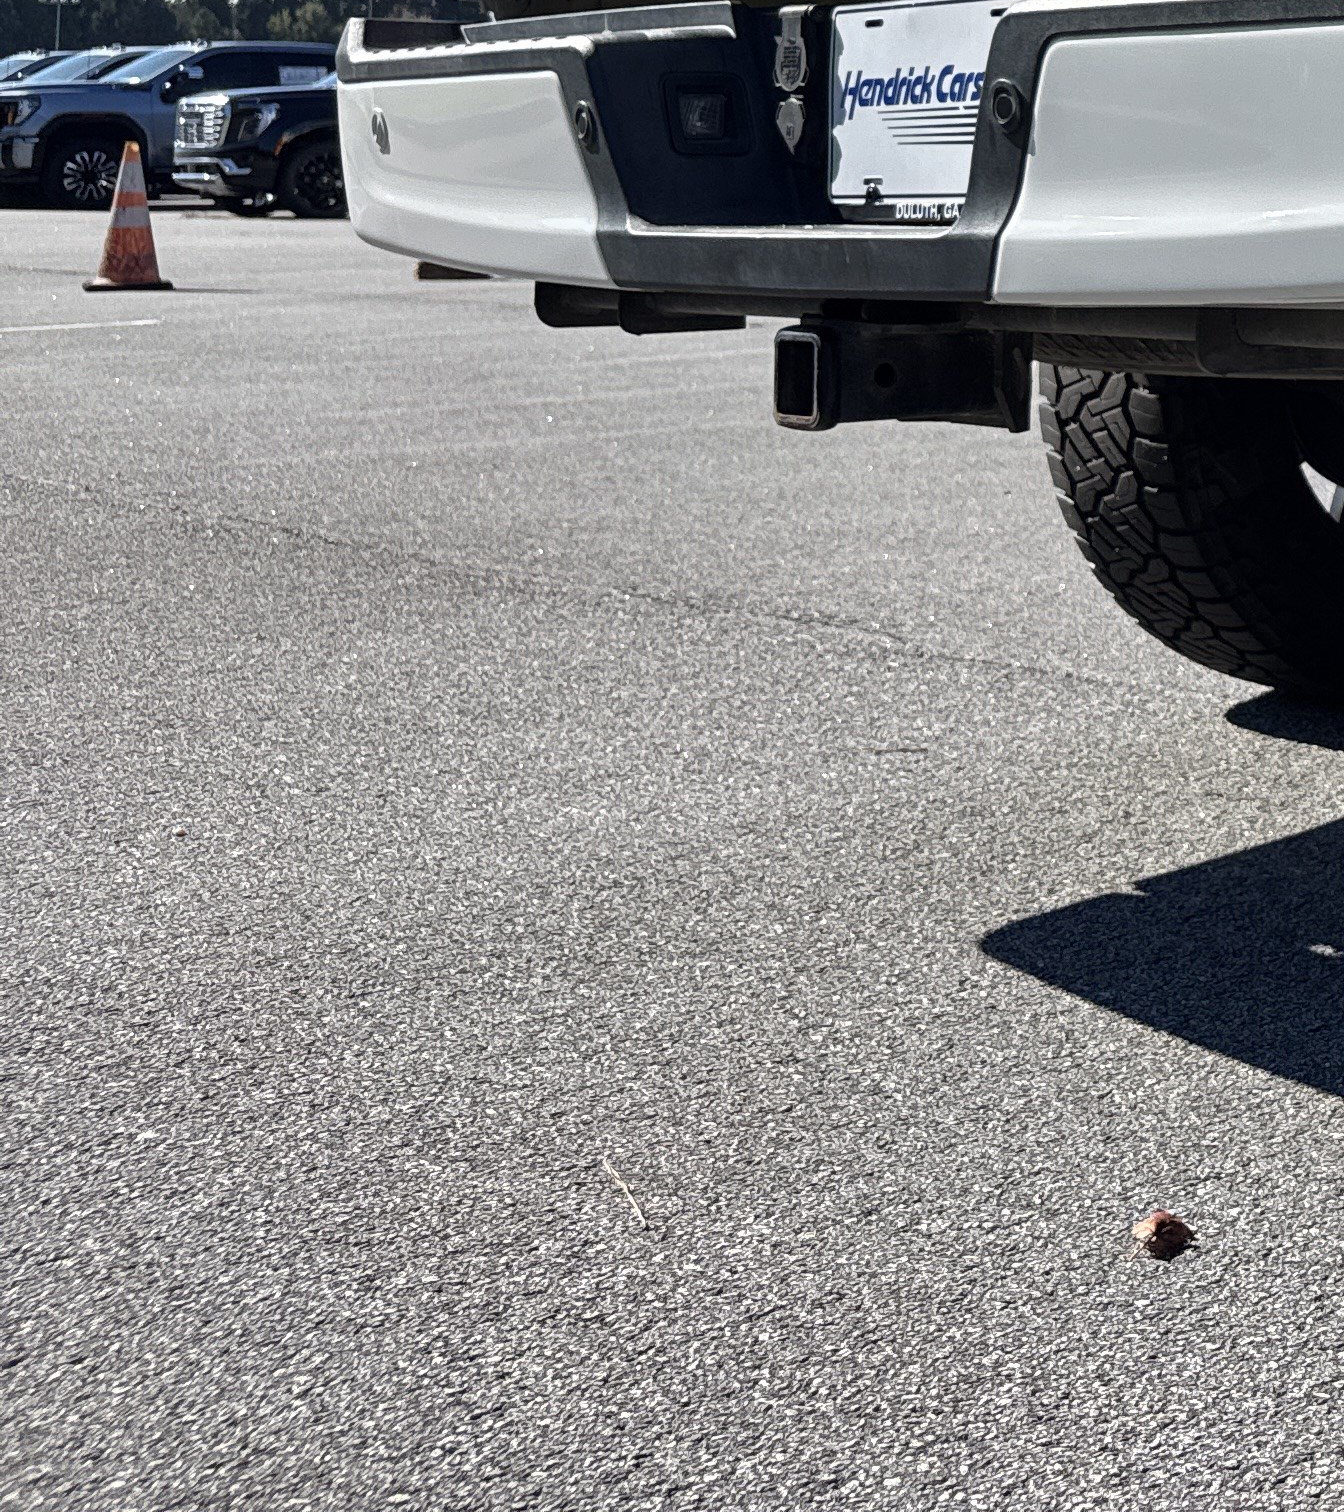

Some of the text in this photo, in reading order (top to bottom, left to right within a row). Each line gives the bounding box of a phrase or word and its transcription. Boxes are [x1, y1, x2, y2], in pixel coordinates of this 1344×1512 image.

[840, 64, 985, 120] Hendrick Cars
[895, 202, 960, 220] DULUTH, GA
